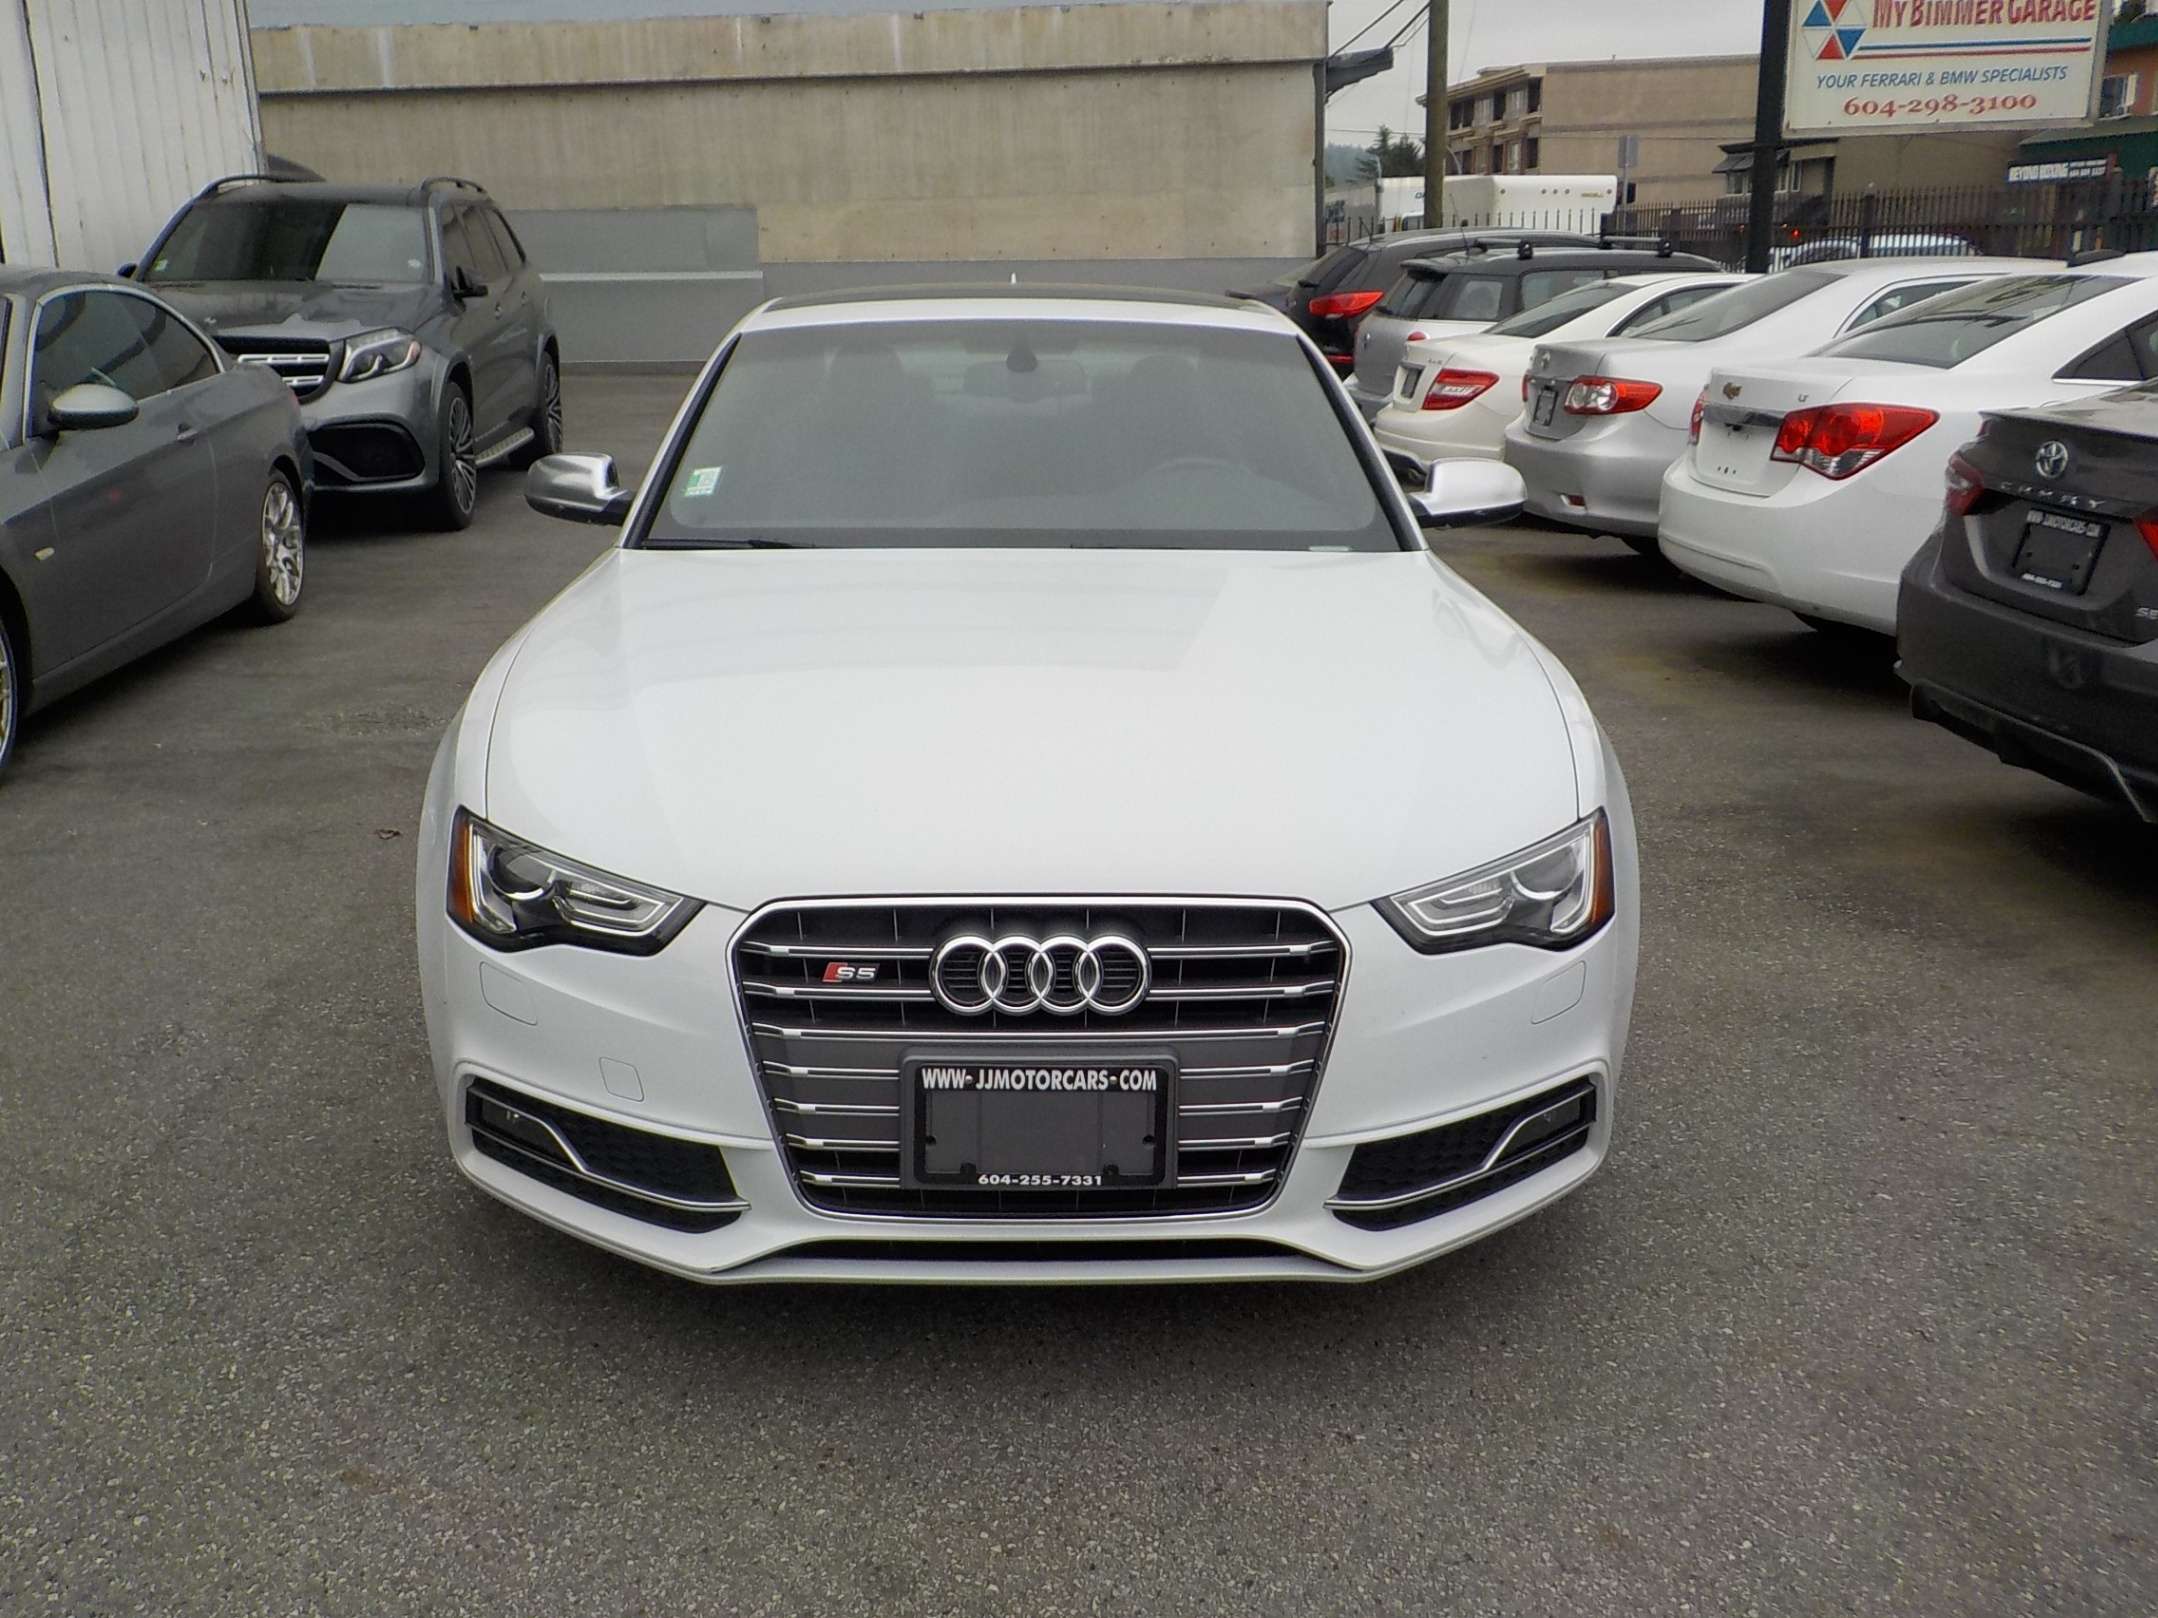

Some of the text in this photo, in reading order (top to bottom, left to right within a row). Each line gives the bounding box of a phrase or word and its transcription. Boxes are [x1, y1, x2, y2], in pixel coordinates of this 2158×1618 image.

[1872, 0, 2096, 28] MY BIMMER GARAGE
[1816, 66, 2069, 89] YOUR FERRARI & BMW SPECIALISTS
[1843, 94, 2037, 118] 604-298-3100
[836, 966, 876, 980] S5
[978, 1174, 1102, 1186] 604-255-7331
